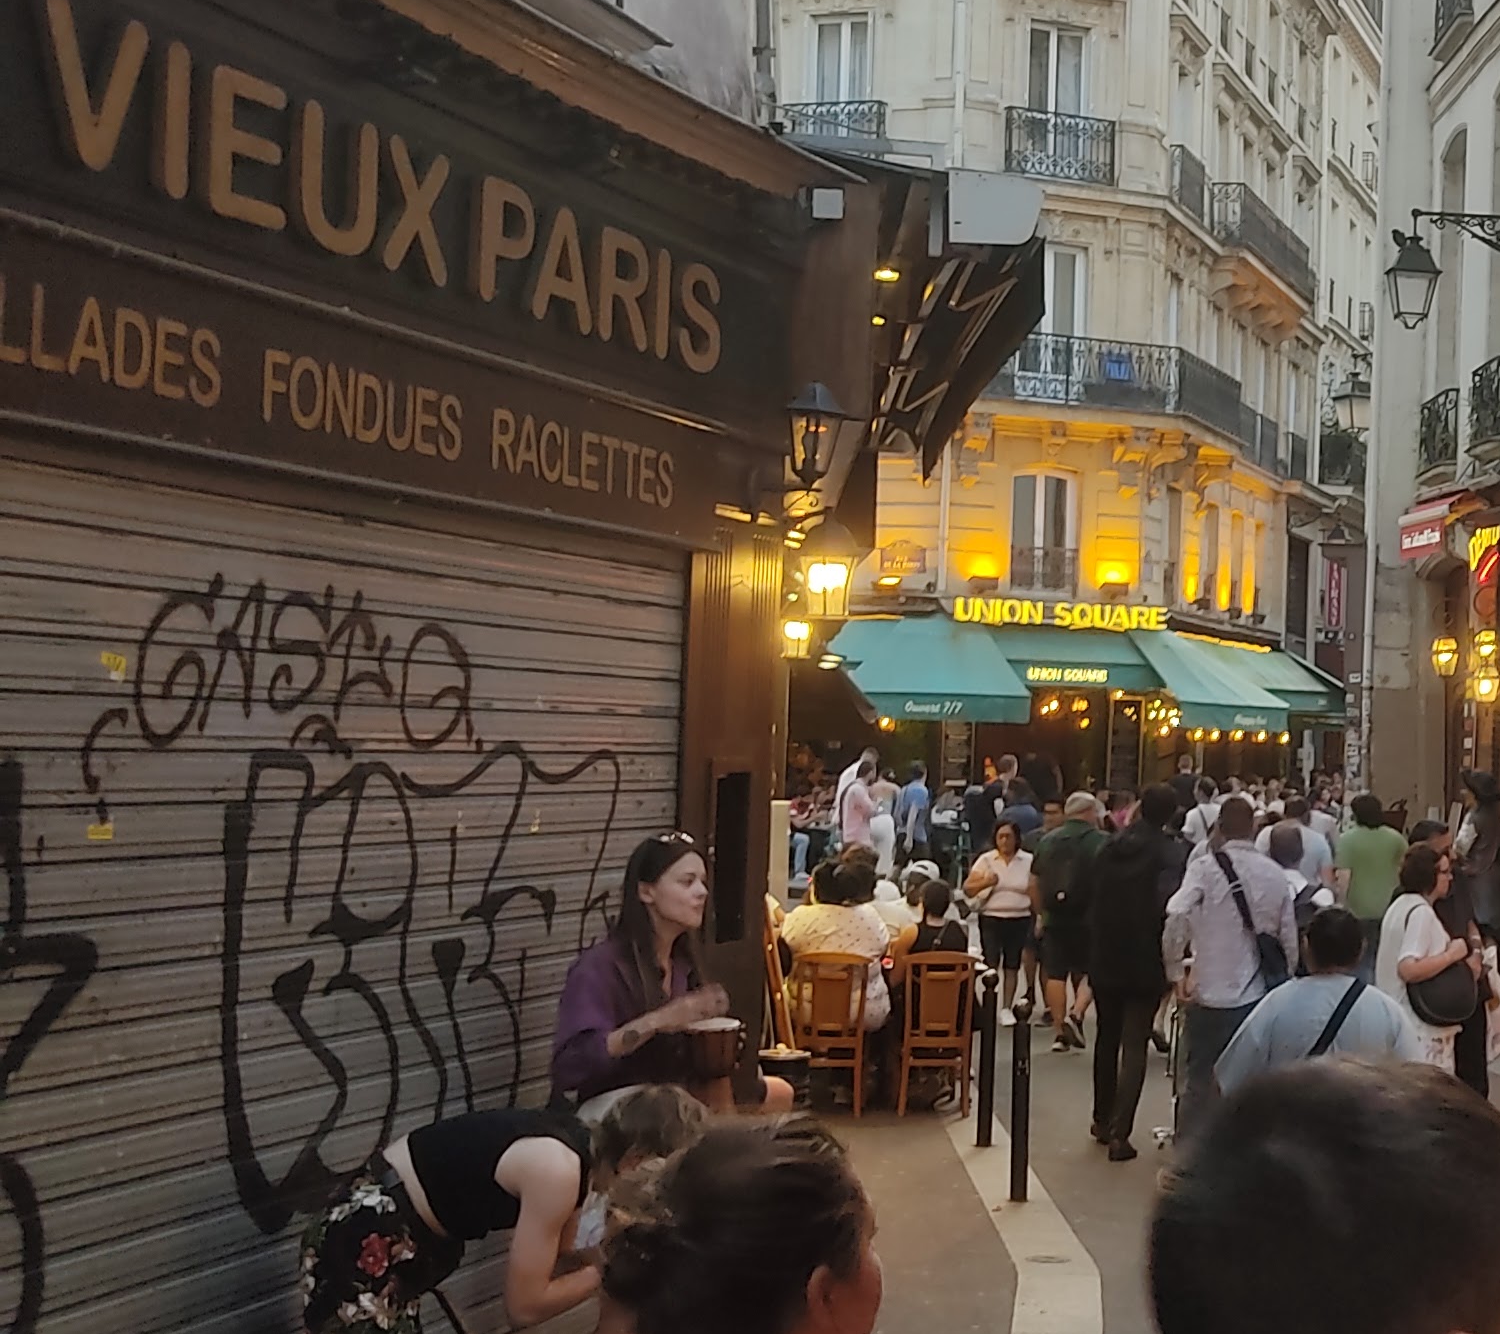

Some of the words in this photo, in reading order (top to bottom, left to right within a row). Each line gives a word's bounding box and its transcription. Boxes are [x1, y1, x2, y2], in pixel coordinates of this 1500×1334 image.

[477, 173, 724, 375] PARIS
[261, 348, 464, 462] FONDUES
[489, 408, 676, 510] RACLETTES
[953, 596, 1044, 626] UNION
[1053, 602, 1170, 632] SQUARE
[942, 700, 963, 715] 7/7
